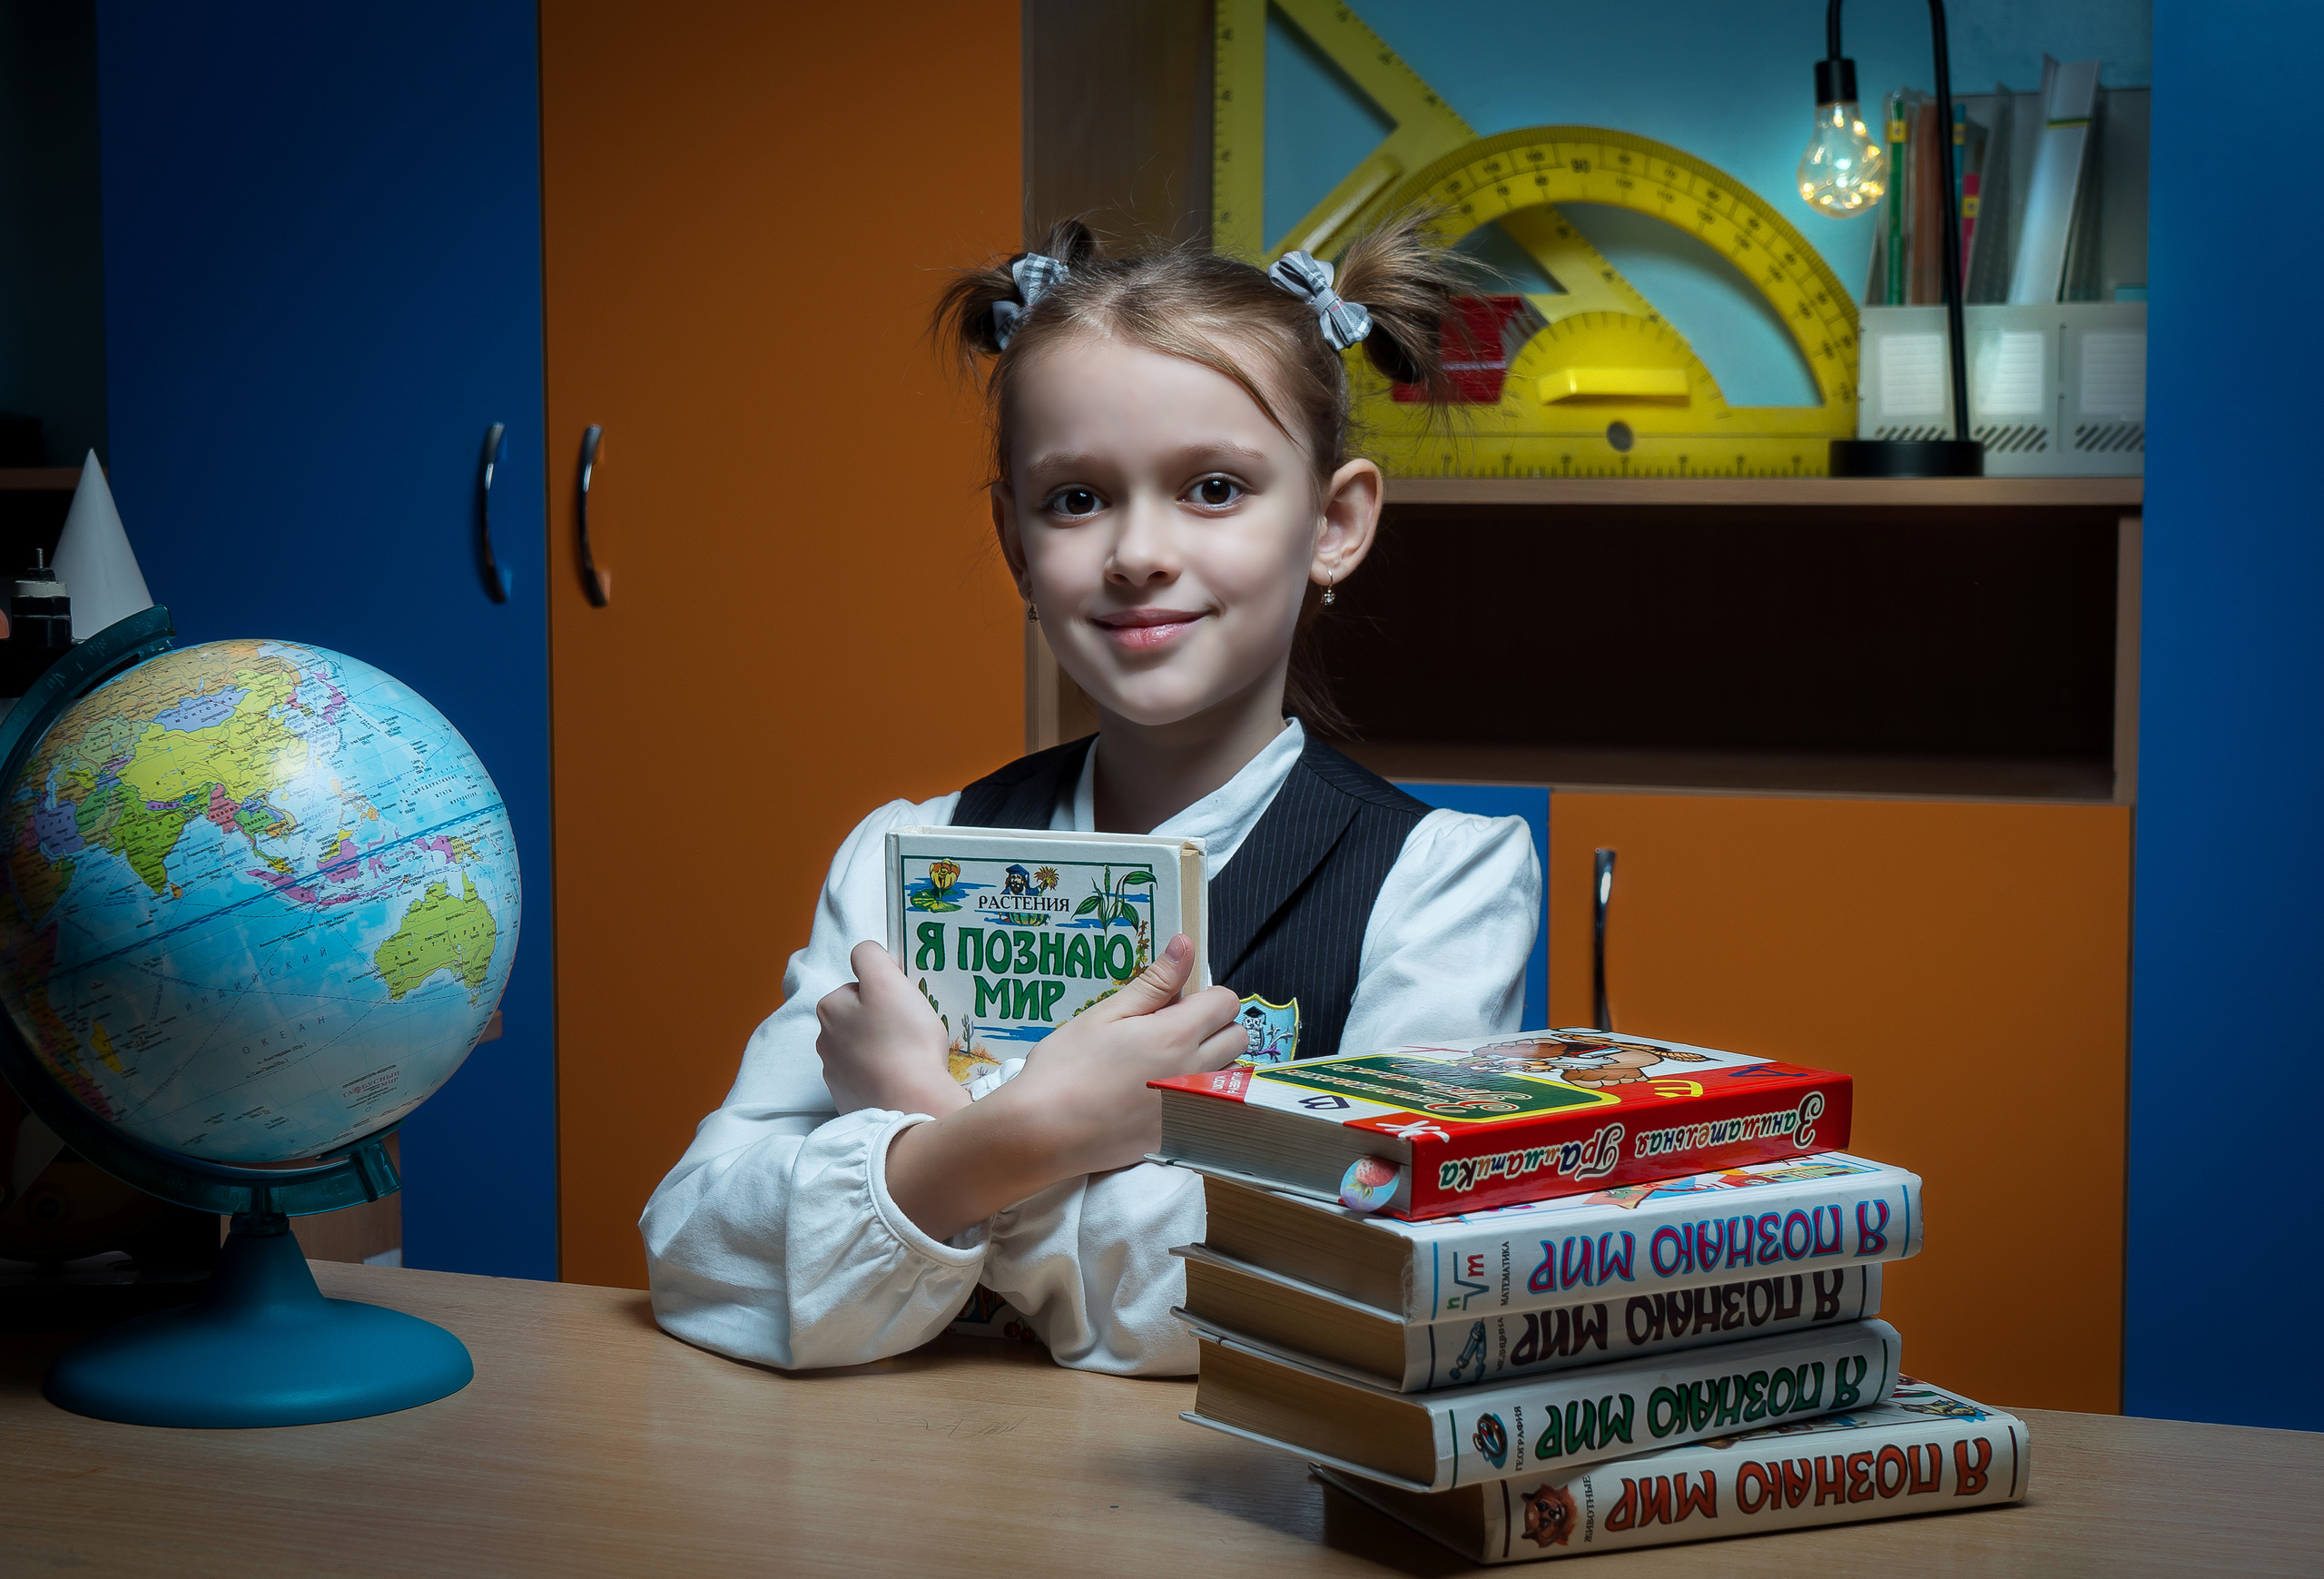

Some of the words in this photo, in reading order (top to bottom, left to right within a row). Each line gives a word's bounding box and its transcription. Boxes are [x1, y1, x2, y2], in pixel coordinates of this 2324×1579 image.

[175, 697, 233, 724] МОНГОЛИЯ
[979, 894, 1070, 913] РАСТЕНИЯ
[395, 923, 484, 961] АВСТРАЛИЯ
[915, 921, 946, 972] Я
[958, 926, 1135, 981] ПОЗНАЮ
[185, 946, 328, 1012] ИНДИЙСКИЙ
[973, 975, 1066, 1022] МИР
[242, 1015, 326, 1055] ОКЕАН
[380, 1077, 399, 1089] МИР
[1298, 1095, 1351, 1110] В
[1375, 1120, 1450, 1144] Ж
[1635, 1090, 1825, 1159] Занимательная
[1439, 1122, 1625, 1192] Грамматика
[1649, 1204, 1844, 1278] ПОЗНАЮ
[1854, 1199, 1891, 1257] Я
[1500, 1240, 1511, 1307] МАТЕМАТИКА
[1526, 1230, 1635, 1295] МИР
[1625, 1270, 1808, 1347] ПОЗНАЮ
[1813, 1268, 1846, 1320] Я
[1495, 1316, 1505, 1372] МЕДИЦИНА
[1510, 1303, 1609, 1367] МИР
[1647, 1362, 1825, 1439] ПОЗНАЮ
[1833, 1355, 1868, 1409] Я
[1514, 1405, 1523, 1472] ГЕОГРАФИЯ
[1535, 1393, 1635, 1460] МИР
[1735, 1442, 1943, 1515] ПОЗНАЮ
[1955, 1437, 1994, 1496] Я
[1582, 1475, 1593, 1543] ЖИВОТНЫЕ
[1604, 1469, 1718, 1532] МИР
